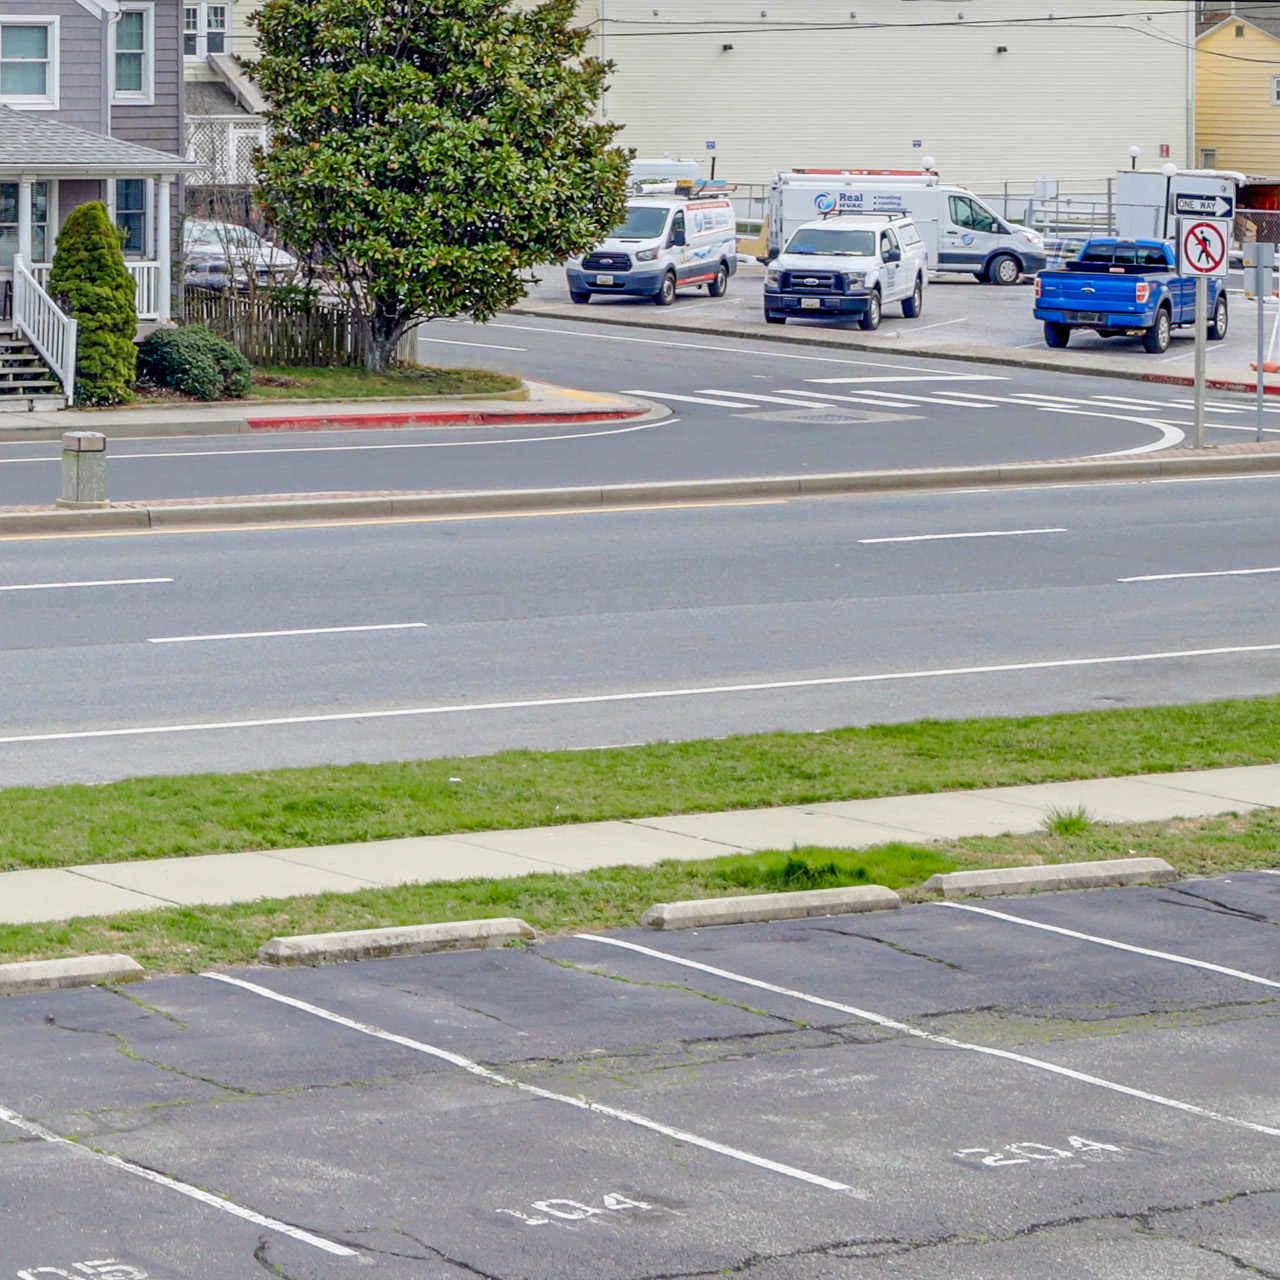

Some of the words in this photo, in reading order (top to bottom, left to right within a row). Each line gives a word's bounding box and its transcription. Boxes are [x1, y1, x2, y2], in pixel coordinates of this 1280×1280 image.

[839, 192, 864, 202] Real
[1178, 199, 1195, 210] ONE
[1200, 201, 1217, 211] WAY
[953, 1135, 1123, 1166] 204
